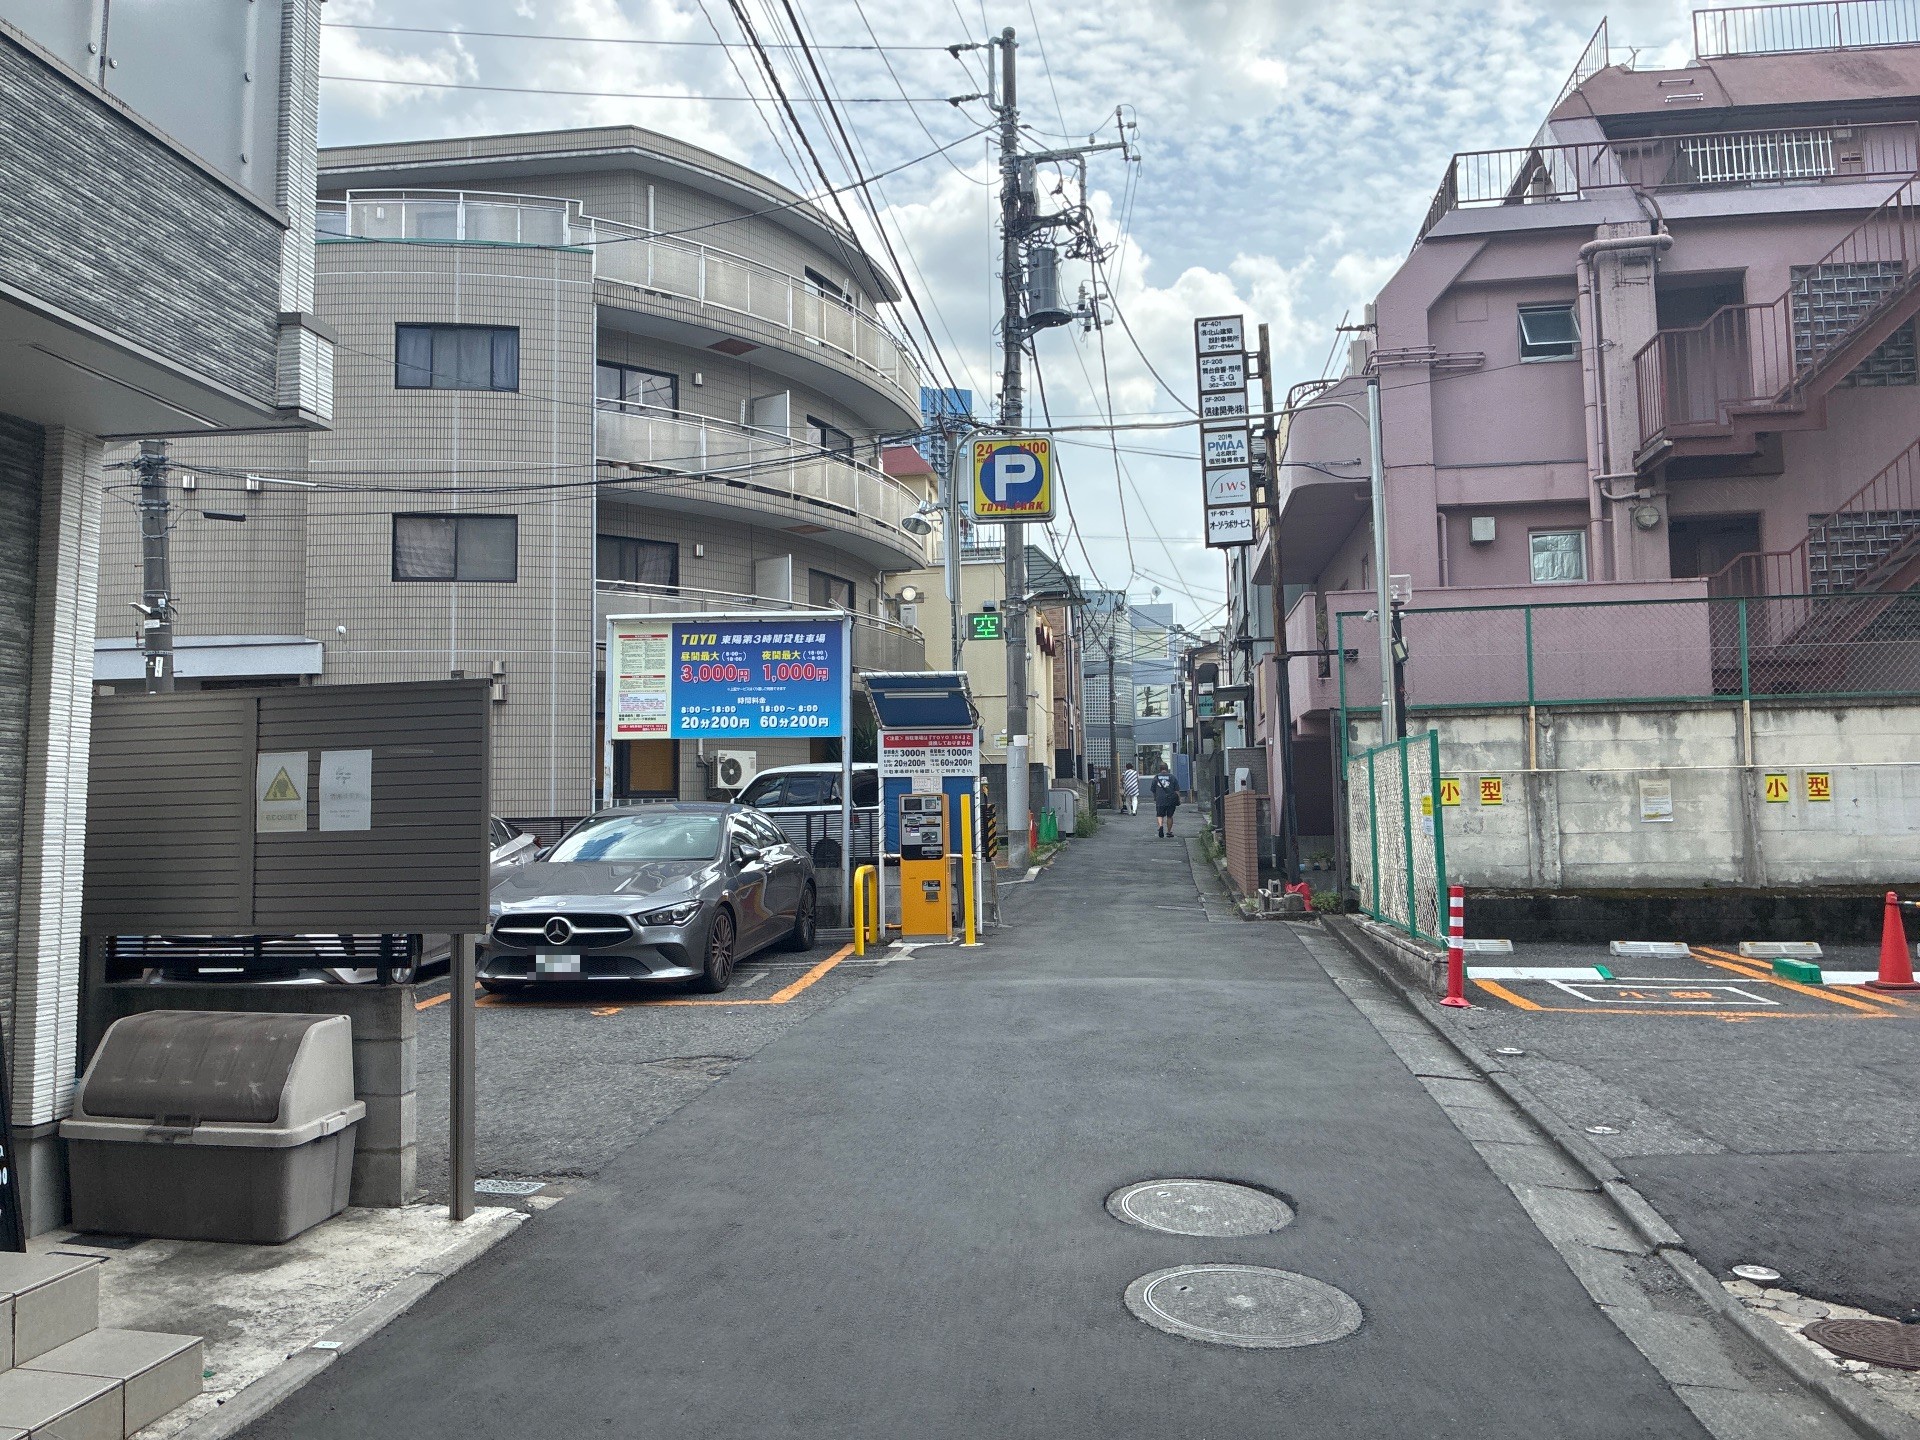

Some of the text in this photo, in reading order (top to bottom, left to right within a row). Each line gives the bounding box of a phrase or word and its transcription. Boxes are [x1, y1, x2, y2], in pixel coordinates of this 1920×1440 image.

[976, 443, 993, 456] 24
[1208, 440, 1244, 451] PMAA
[995, 453, 1036, 501] P
[1014, 501, 1044, 510] PARK
[973, 615, 999, 638] 空
[681, 634, 717, 645] TOYO
[721, 633, 826, 644] 東陽第3時間貸駐車場
[681, 651, 720, 661] 昼間最大
[761, 650, 801, 660] 夜間最大
[680, 663, 751, 683] 3,000円
[762, 662, 829, 682] 1,000円
[737, 696, 767, 704] 時間料金
[681, 716, 750, 729] 20分200円
[759, 715, 829, 728] 60分200円
[900, 749, 926, 757] 3000円
[947, 748, 973, 757] 1000円
[940, 759, 973, 767] 60分200円
[1440, 781, 1502, 801] 小 型
[1767, 776, 1830, 797] 小 型
